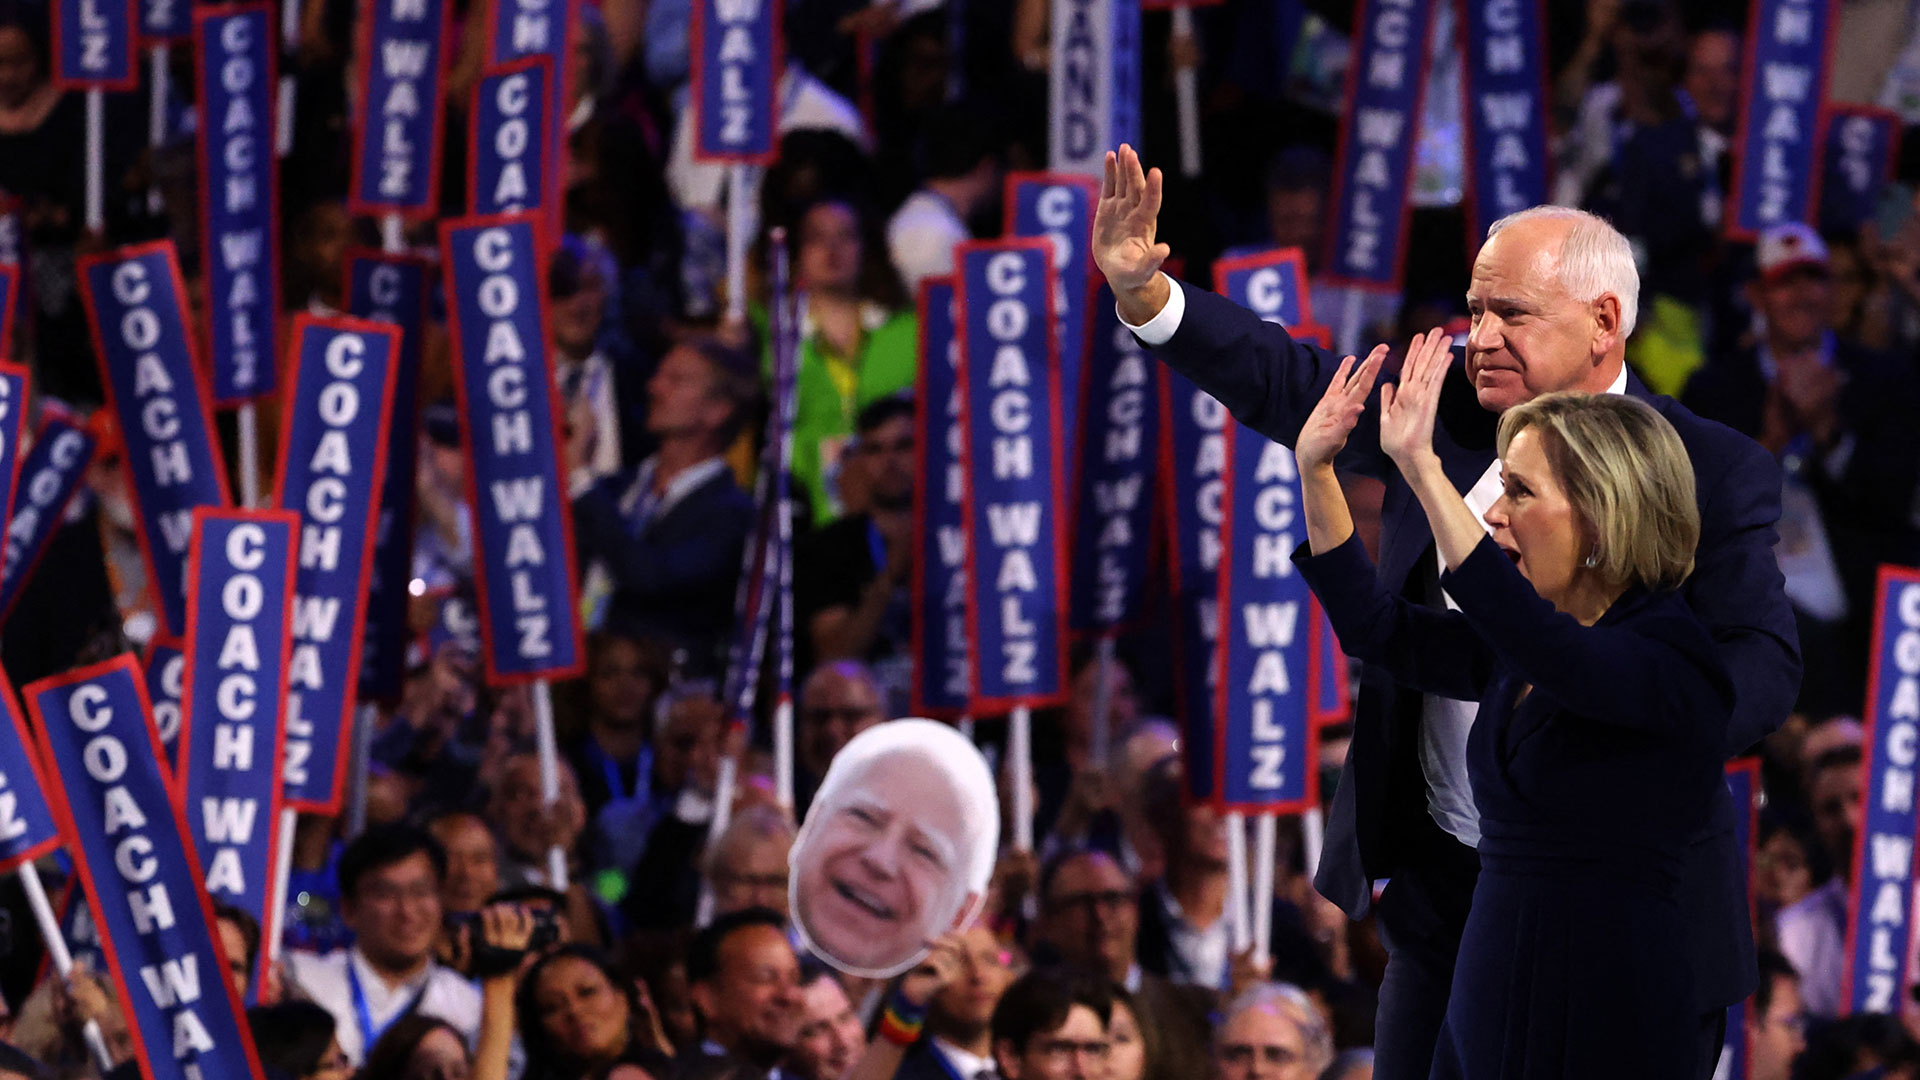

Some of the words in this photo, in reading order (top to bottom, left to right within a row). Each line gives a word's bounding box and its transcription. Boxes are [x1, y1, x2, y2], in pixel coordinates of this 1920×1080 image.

[78, 0, 109, 70] LZ
[221, 17, 258, 213] COACH
[377, 38, 430, 196] WALZ
[714, 0, 760, 144] WALZ
[1064, 0, 1096, 161] AND
[494, 72, 529, 217] COA
[1346, 108, 1403, 271] WALZ
[1481, 93, 1532, 212] WAL
[112, 261, 192, 487] COACH
[220, 230, 262, 390] WALZ
[473, 228, 533, 455] COACH
[985, 252, 1034, 479] COACH
[2, 429, 84, 580] COA
[299, 334, 366, 571] COACH
[1252, 438, 1297, 578] ACH
[213, 523, 267, 771] COACH
[490, 475, 553, 659] WALZ
[986, 502, 1042, 684] WALZ
[283, 595, 341, 786] WALZ
[1243, 602, 1298, 789] WALZ
[1882, 583, 1920, 813] COACH
[69, 684, 176, 935] COACH
[140, 953, 215, 1080] WA
[203, 798, 257, 894] WA
[1864, 832, 1914, 1012] WALZ
